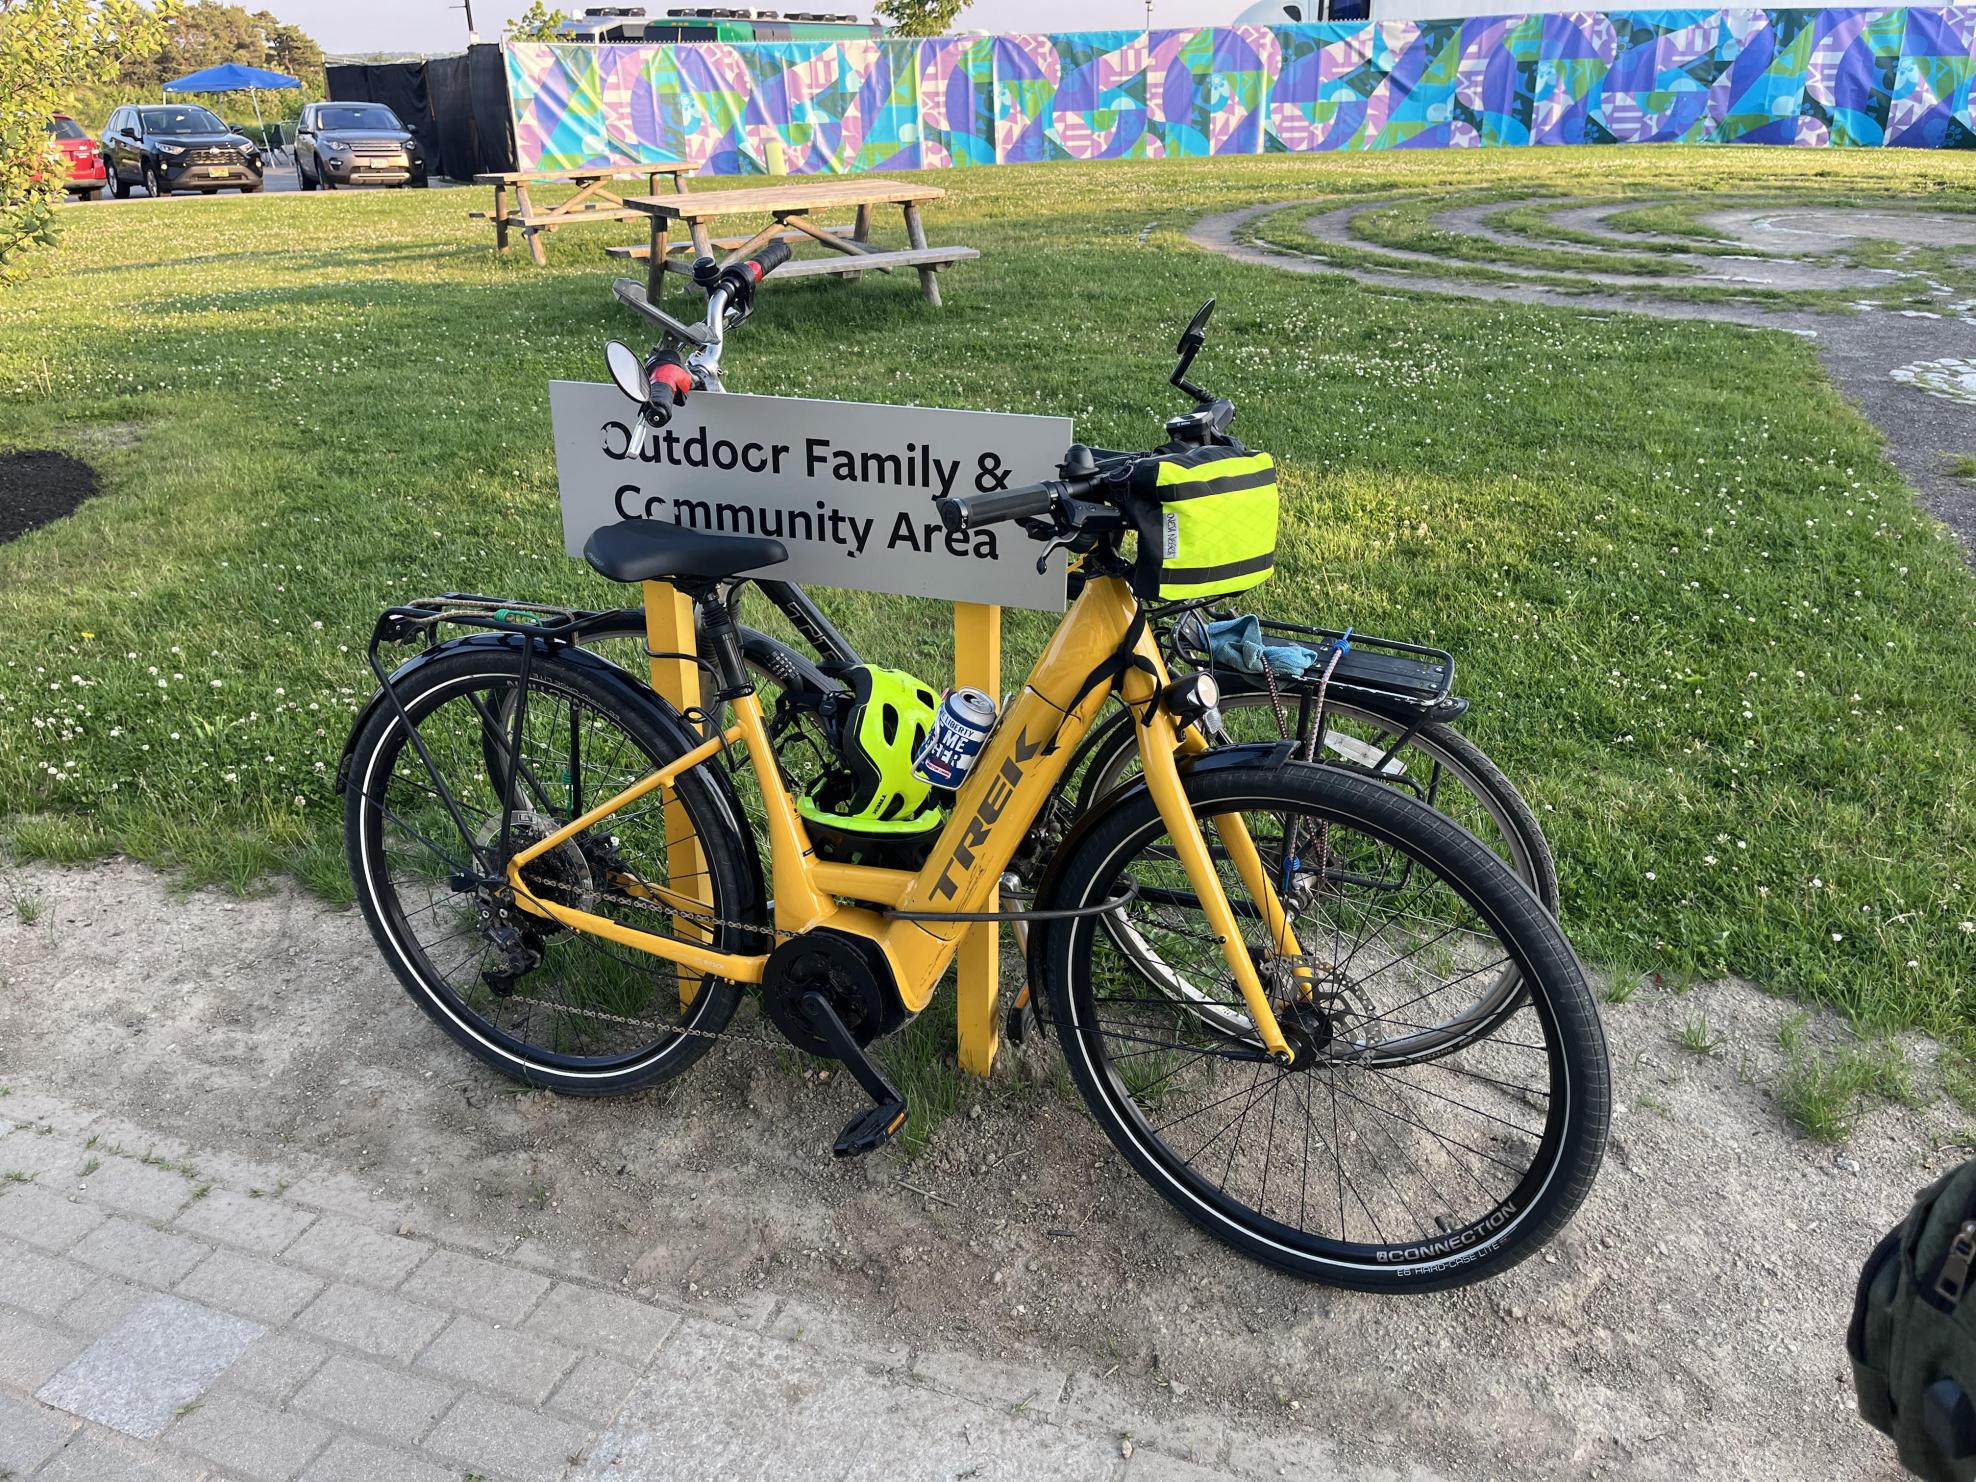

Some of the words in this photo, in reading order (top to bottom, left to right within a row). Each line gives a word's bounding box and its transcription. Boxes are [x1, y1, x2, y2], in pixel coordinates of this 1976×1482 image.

[600, 420, 790, 474] Outdoor
[805, 437, 961, 502] Family
[974, 451, 1013, 494] &
[886, 511, 999, 561] Area
[942, 729, 969, 752] ME
[945, 716, 975, 738] LIBERTY
[928, 724, 1042, 901] TREK
[1389, 1201, 1517, 1261] CONNECTION
[1479, 1241, 1500, 1257] LITE
